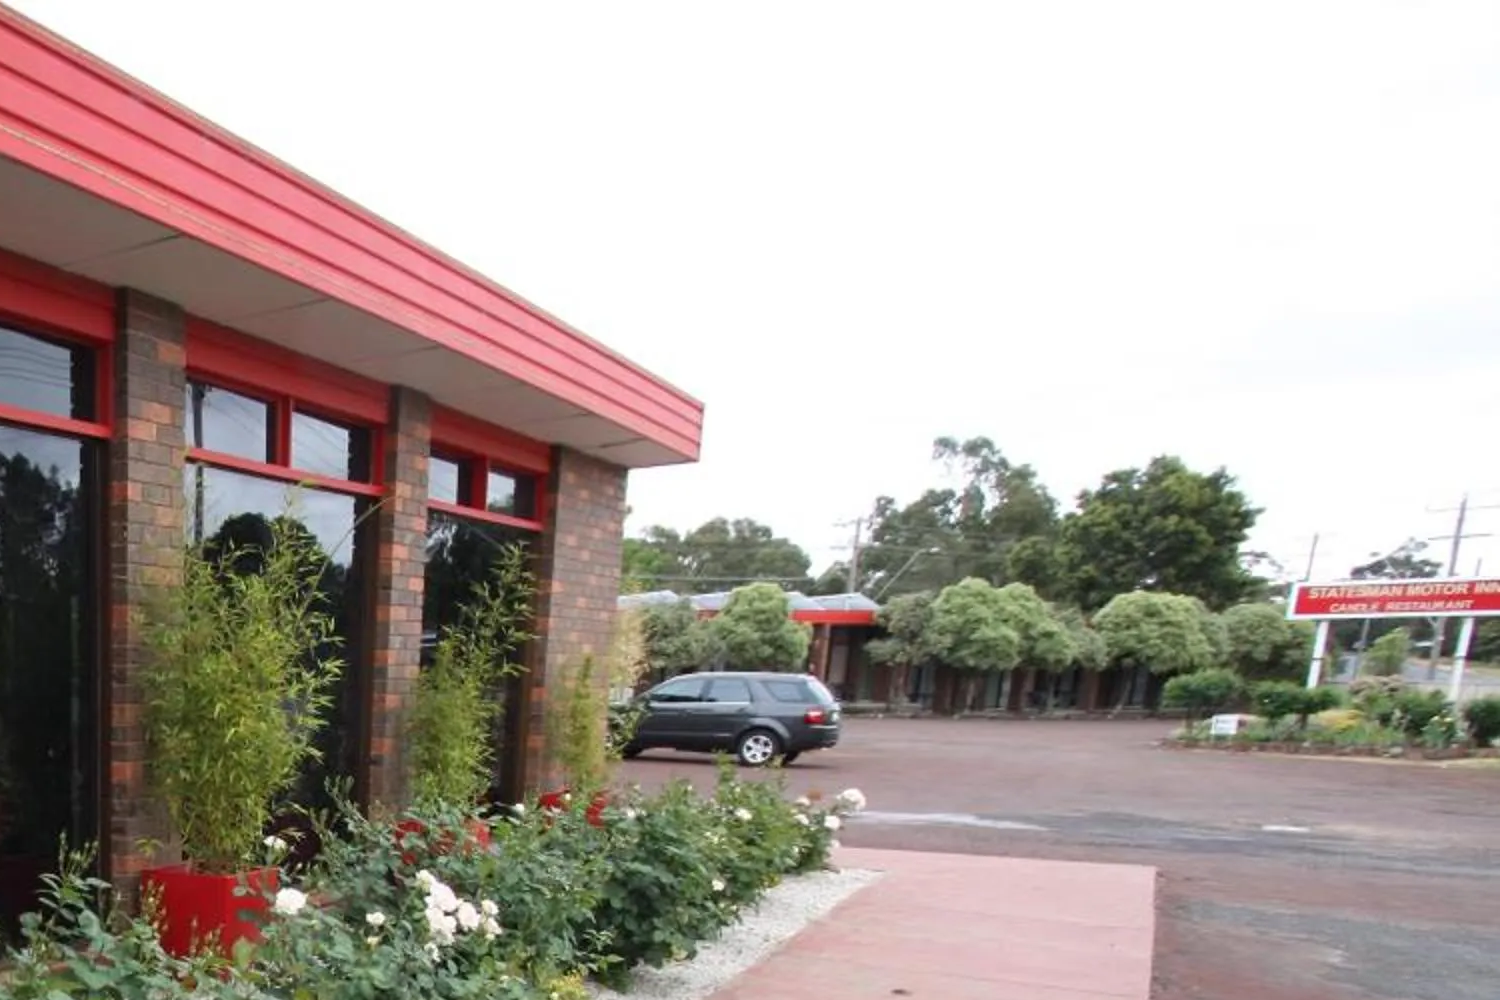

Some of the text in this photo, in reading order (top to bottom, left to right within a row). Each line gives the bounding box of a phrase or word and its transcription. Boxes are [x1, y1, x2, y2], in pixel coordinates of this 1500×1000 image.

[1308, 585, 1404, 599] STATESMAN
[1406, 582, 1472, 597] MOTOR
[1382, 599, 1475, 611] RESTAURANT
